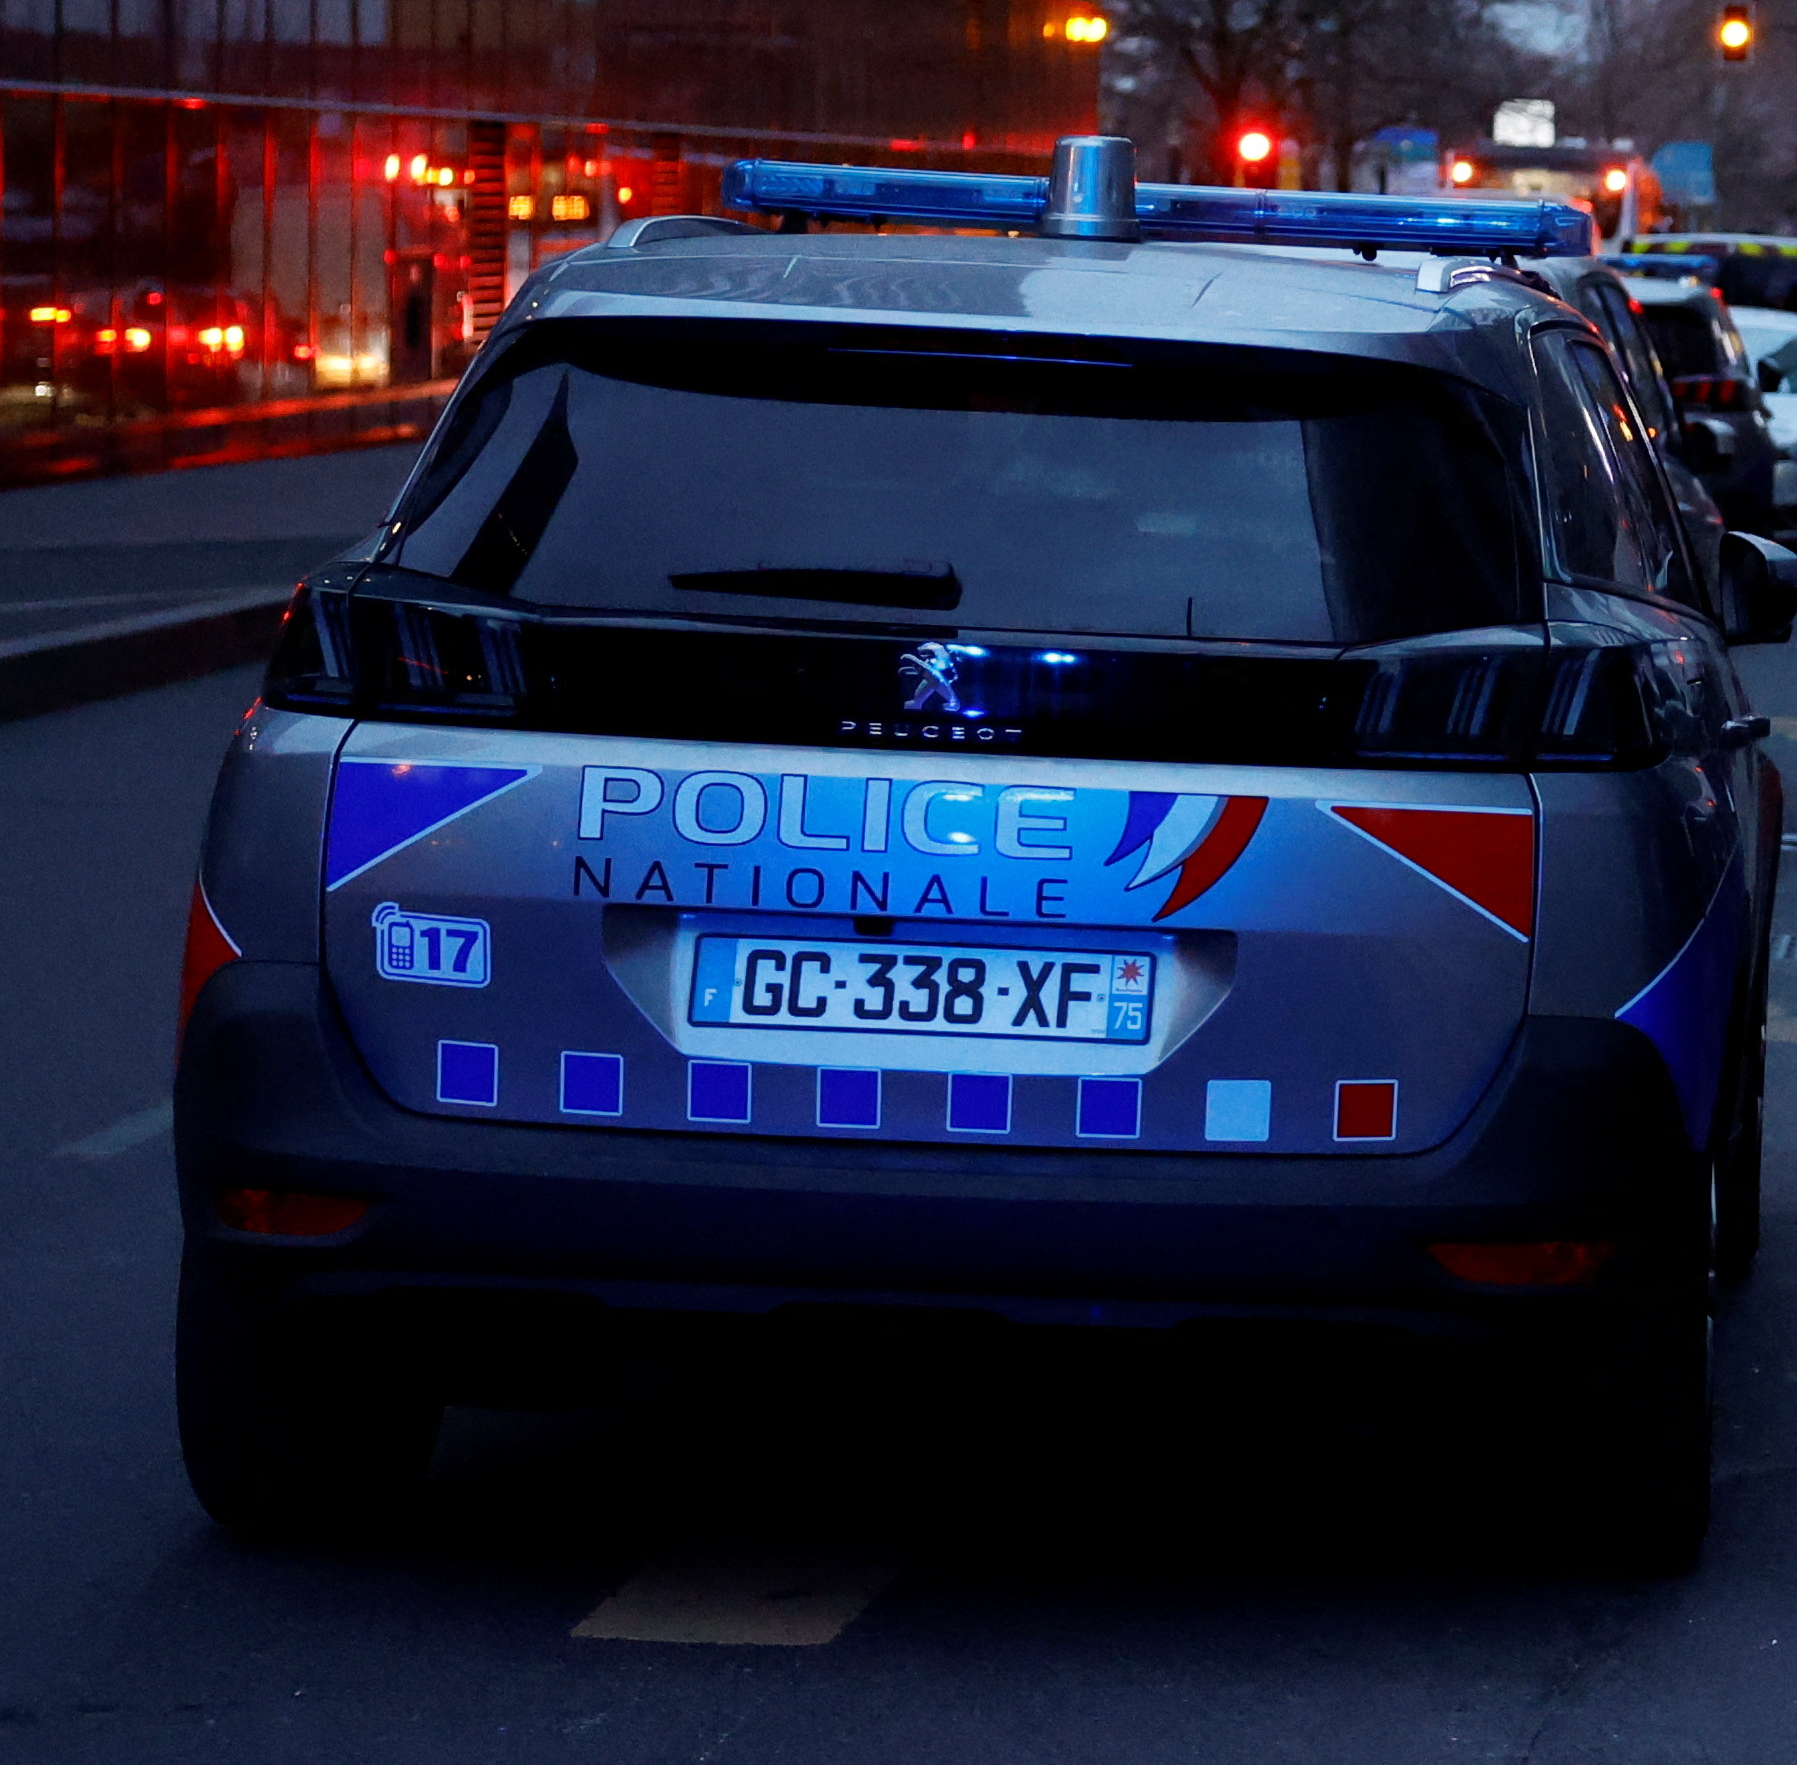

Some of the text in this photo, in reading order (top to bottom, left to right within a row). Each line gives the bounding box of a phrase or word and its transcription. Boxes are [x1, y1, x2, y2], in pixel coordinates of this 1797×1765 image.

[577, 765, 1077, 860] POLICE
[573, 856, 1068, 918] NATIONALE
[419, 927, 479, 973] 17
[704, 949, 1143, 1030] F GC-338-XF 75
